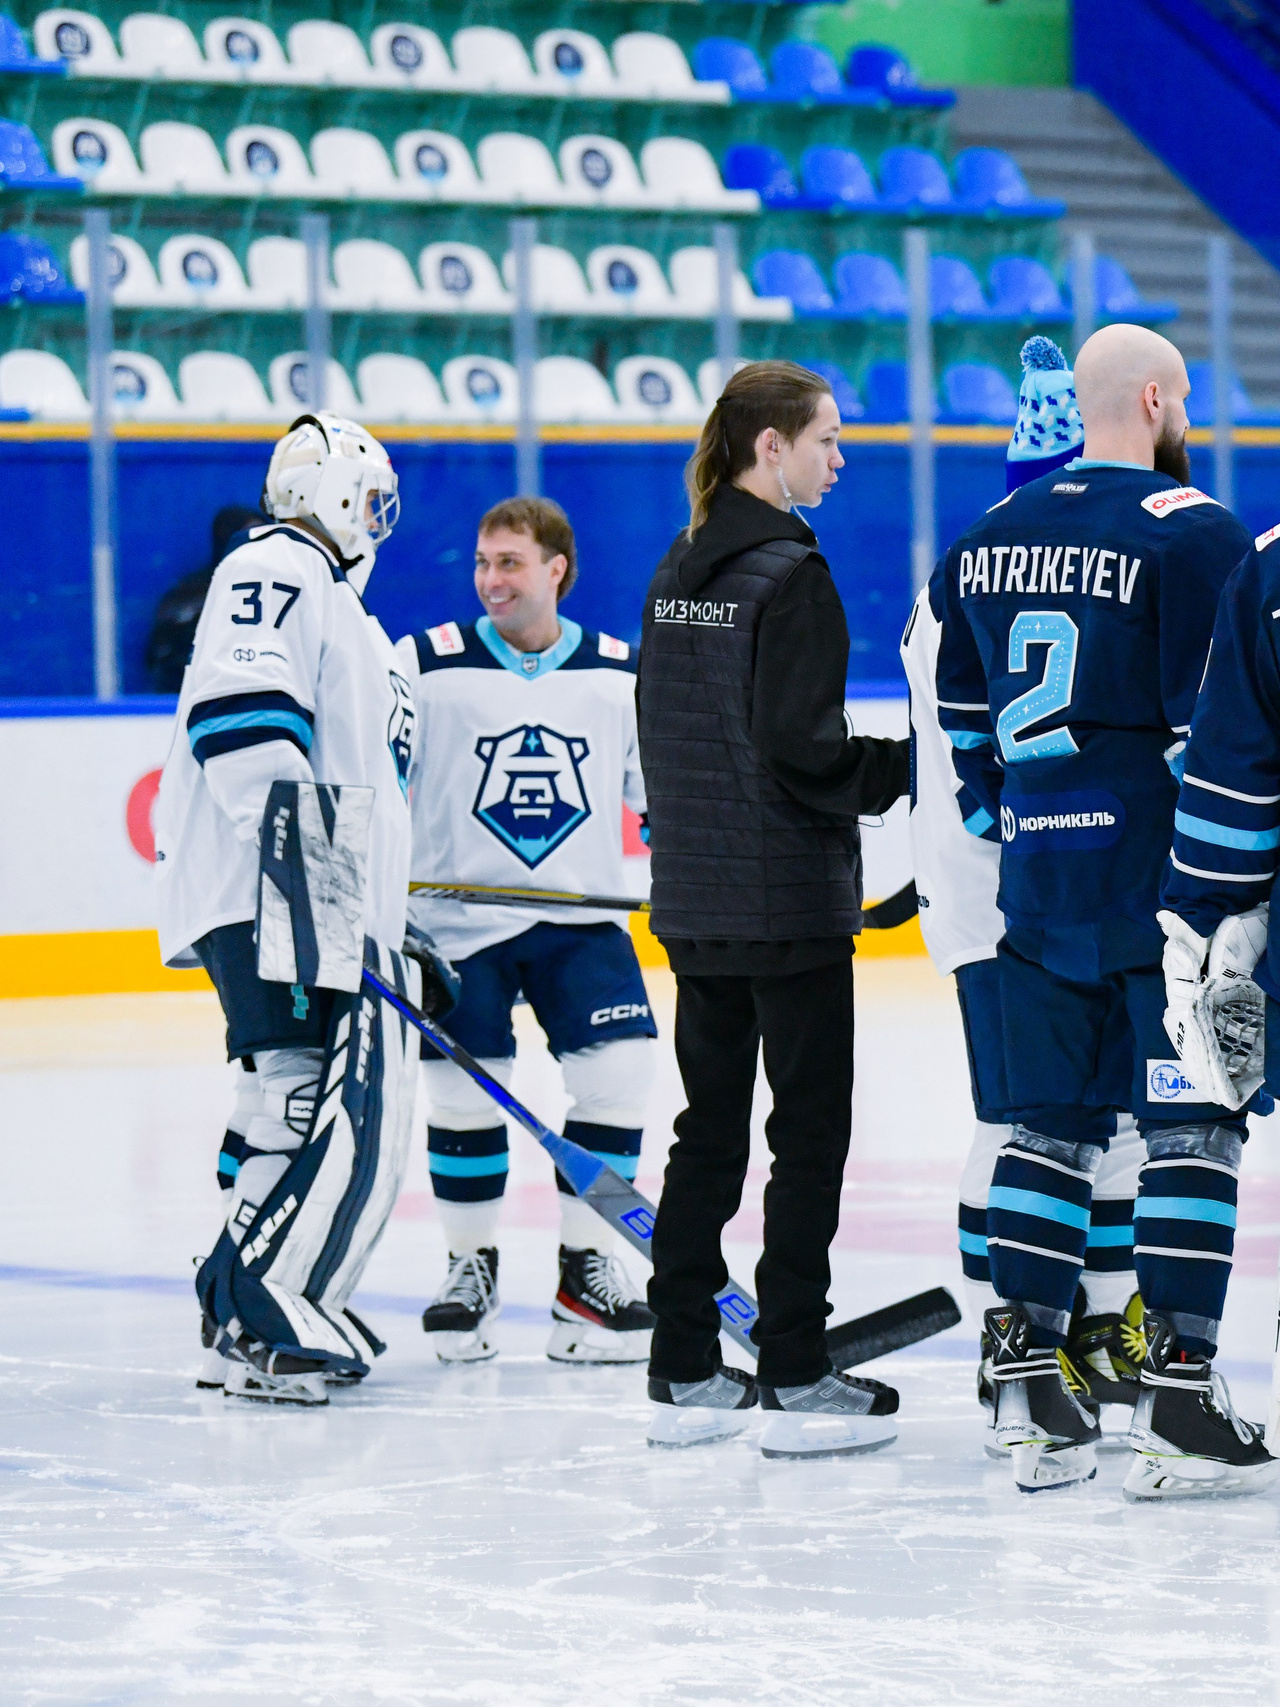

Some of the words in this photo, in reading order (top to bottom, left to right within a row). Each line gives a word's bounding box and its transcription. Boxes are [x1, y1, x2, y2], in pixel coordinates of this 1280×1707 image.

[959, 545, 1141, 604] PATRIKEYEV
[231, 581, 302, 629] 37
[654, 599, 738, 623] БИЗМОНТ
[996, 610, 1080, 764] 2
[1018, 811, 1116, 832] НОРНИКЕЛЬ
[589, 1003, 649, 1026] CCM
